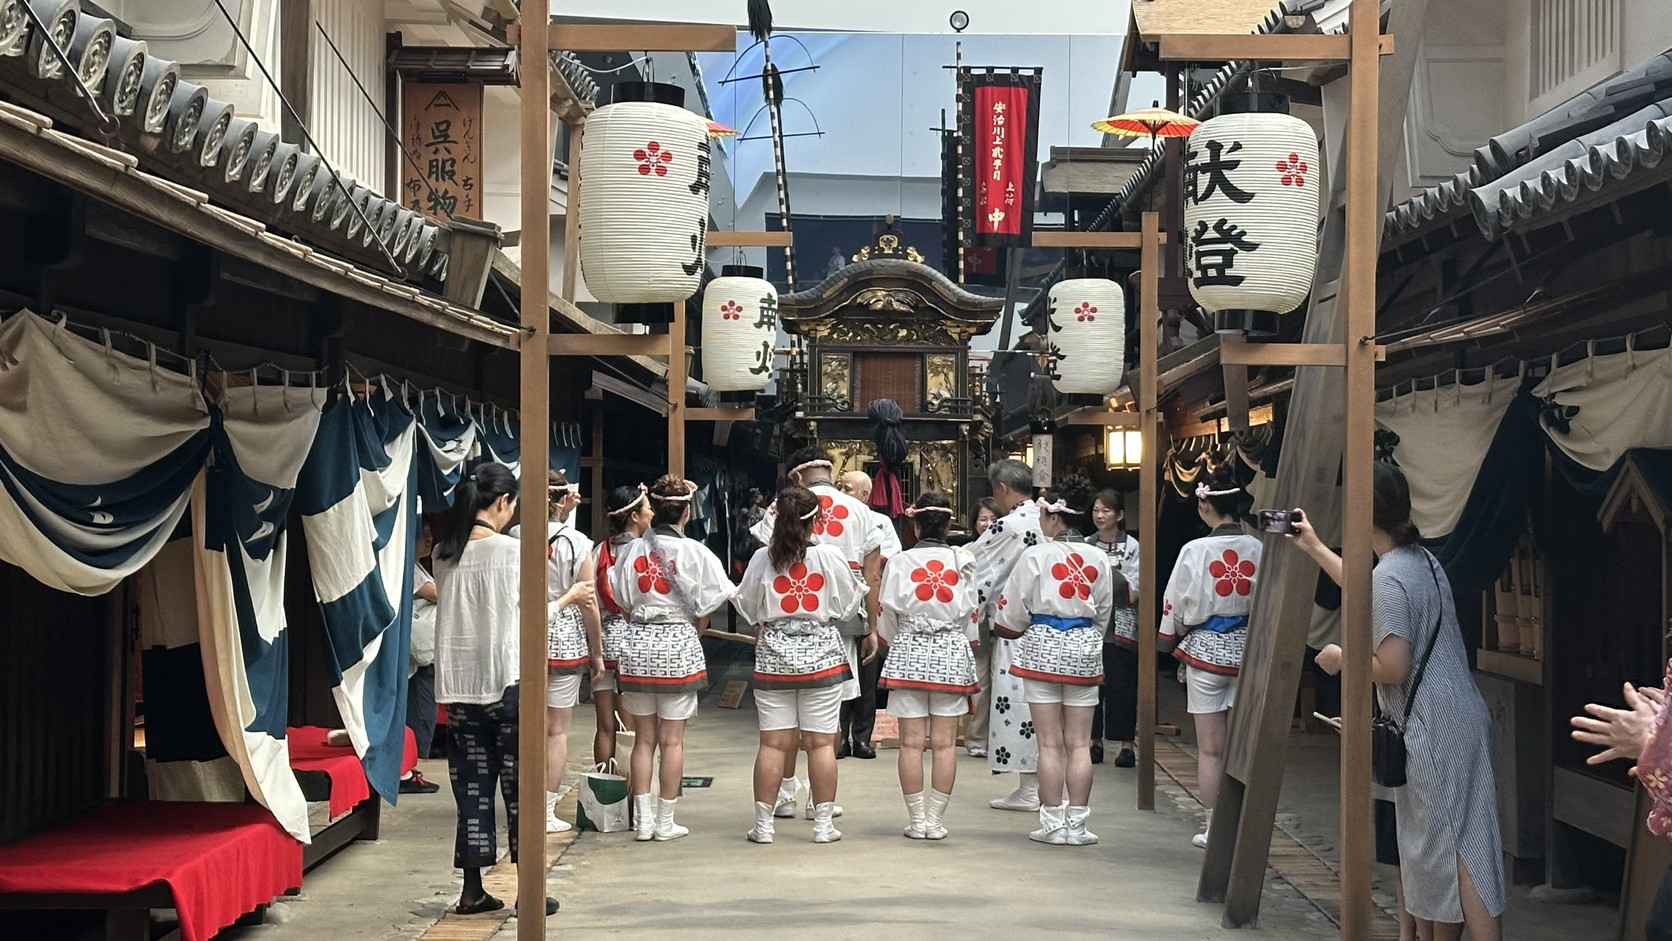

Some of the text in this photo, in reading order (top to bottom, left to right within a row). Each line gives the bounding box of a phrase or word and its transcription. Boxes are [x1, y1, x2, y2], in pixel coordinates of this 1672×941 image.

[424, 121, 459, 217] 呉服物
[988, 207, 1005, 232] 中
